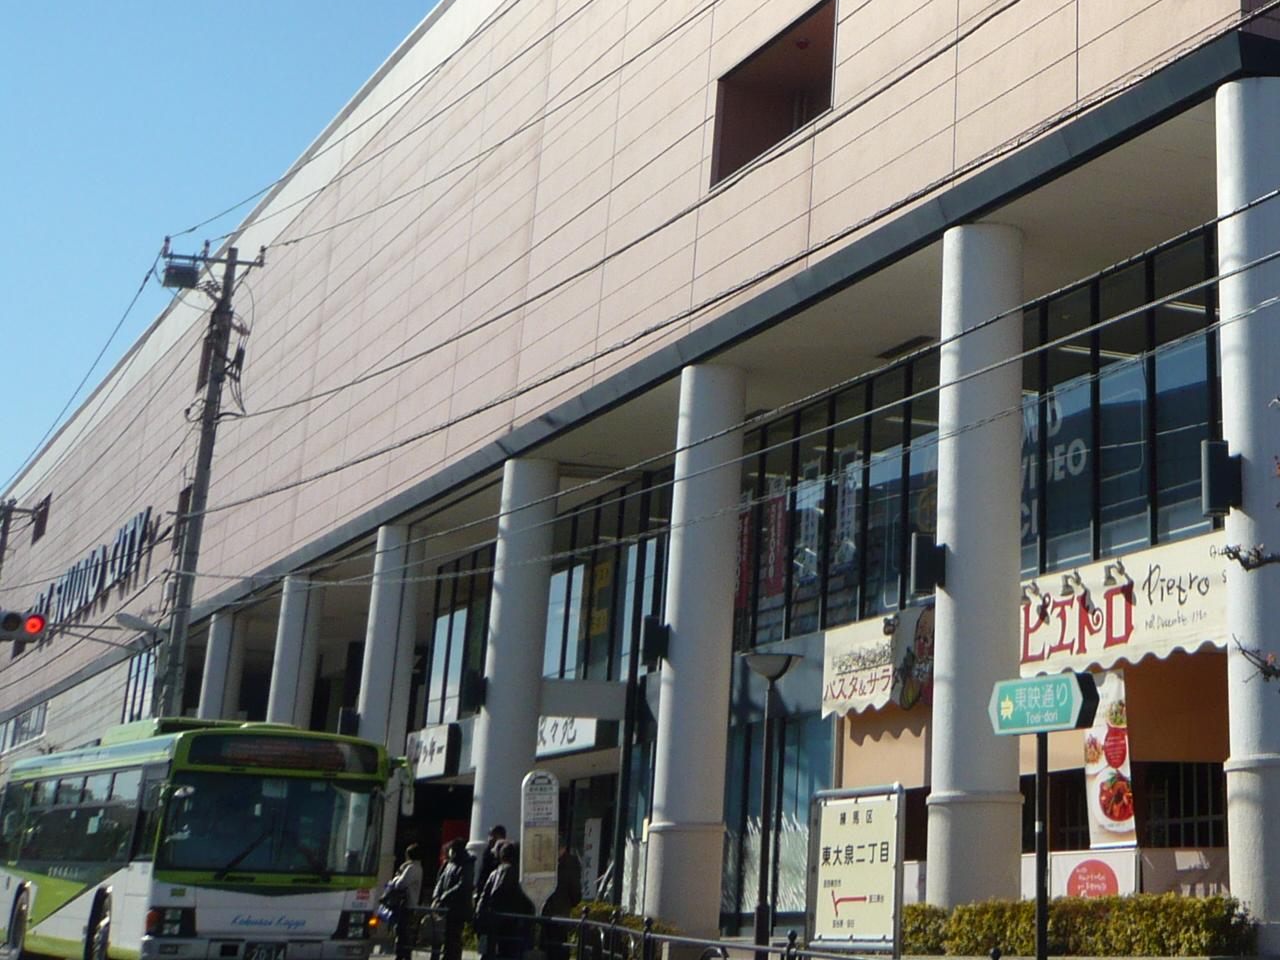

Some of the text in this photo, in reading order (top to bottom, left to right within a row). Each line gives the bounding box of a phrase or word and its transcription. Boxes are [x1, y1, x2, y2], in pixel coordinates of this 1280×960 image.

[107, 506, 153, 587] CITY
[1142, 563, 1210, 606] Pietro
[1020, 584, 1134, 665] ピエトロ
[1014, 682, 1068, 712] 東映通り
[839, 809, 873, 826] 練馬区
[821, 841, 889, 867] 東大泉二丁目
